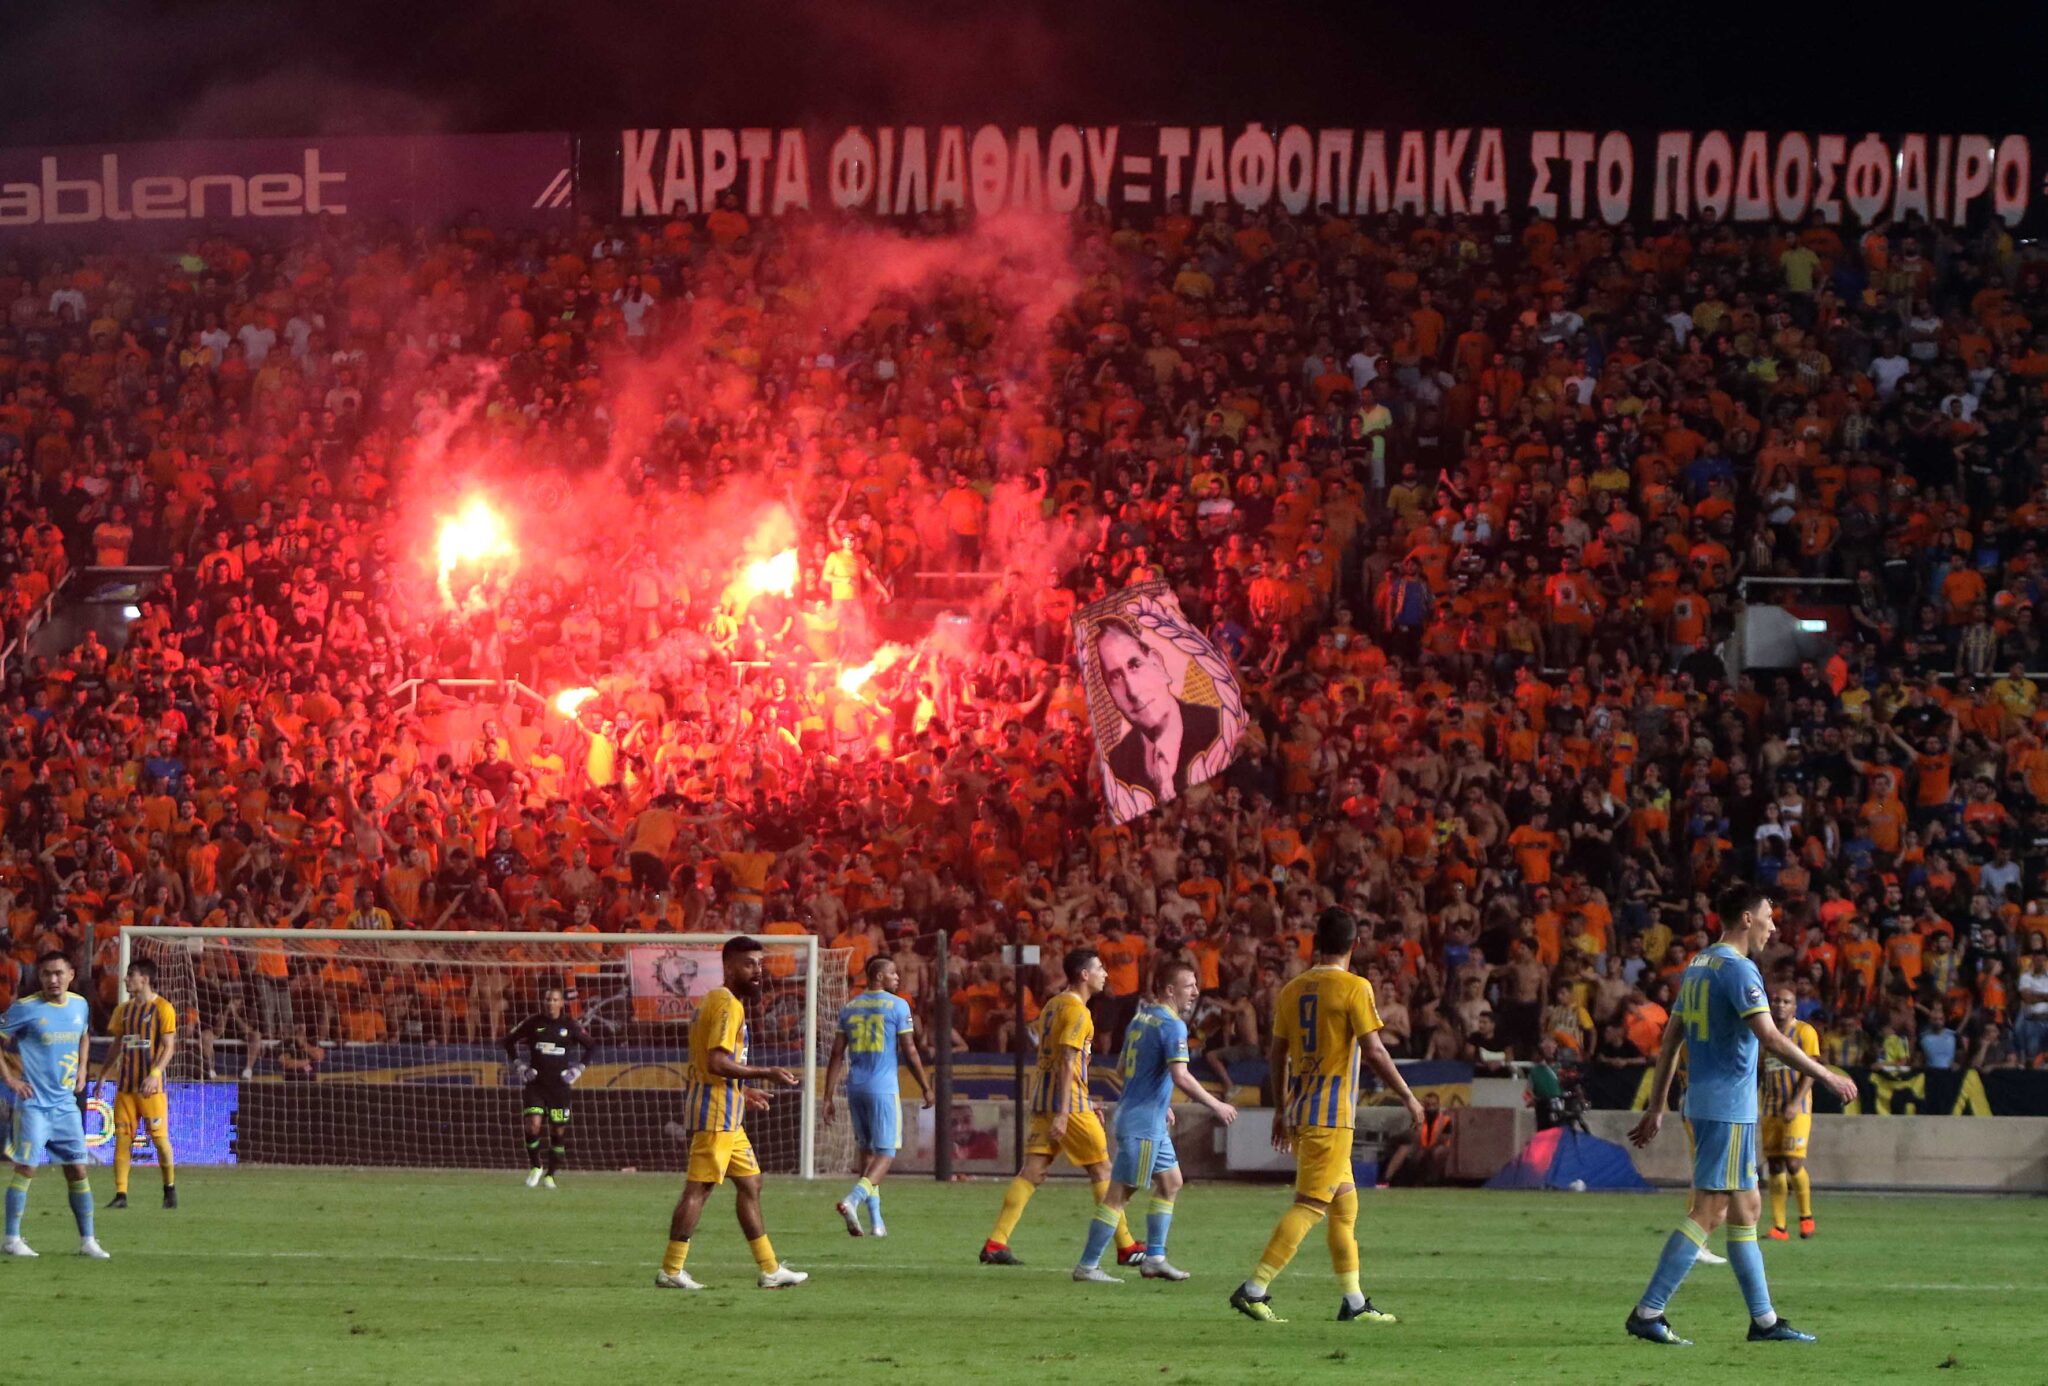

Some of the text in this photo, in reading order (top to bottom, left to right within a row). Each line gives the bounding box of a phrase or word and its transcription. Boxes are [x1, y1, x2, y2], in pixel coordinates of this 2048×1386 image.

[620, 127, 810, 217] ΚΑΡΤΑ
[1529, 130, 1634, 225] ΣΤΟ
[1653, 130, 2031, 228] ΠΟΔΟΣΦΑΙΡΟ
[848, 1013, 885, 1053] 30
[1299, 994, 1318, 1052] 9
[1682, 977, 1709, 1041] 44
